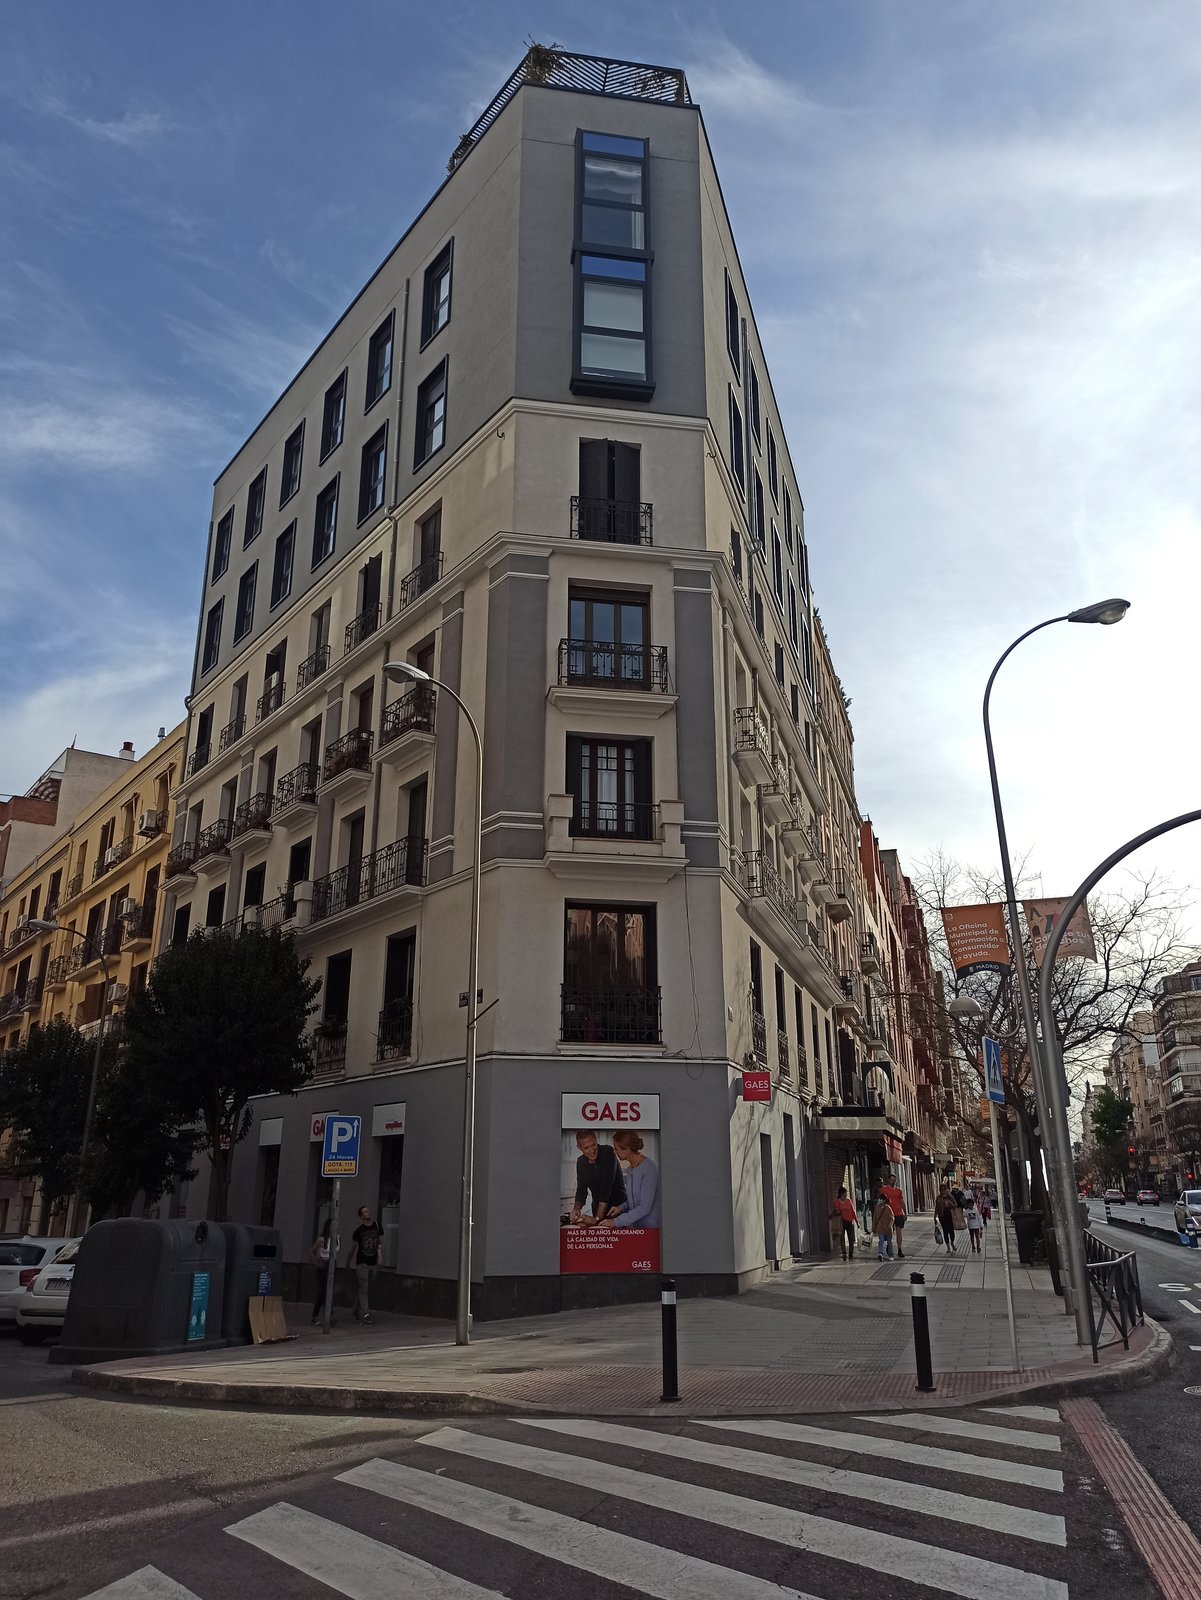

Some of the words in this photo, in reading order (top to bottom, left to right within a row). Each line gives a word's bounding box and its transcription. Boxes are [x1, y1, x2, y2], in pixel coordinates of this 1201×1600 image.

[958, 922, 988, 930] Oficina
[949, 928, 988, 940] Municipal
[953, 942, 1000, 954] Consumidor
[1036, 937, 1084, 951] dechos
[962, 950, 990, 959] ayuda.
[744, 1080, 769, 1089] GAES
[581, 1101, 641, 1122] GAES
[313, 1119, 325, 1136] GA
[331, 1122, 353, 1152] P
